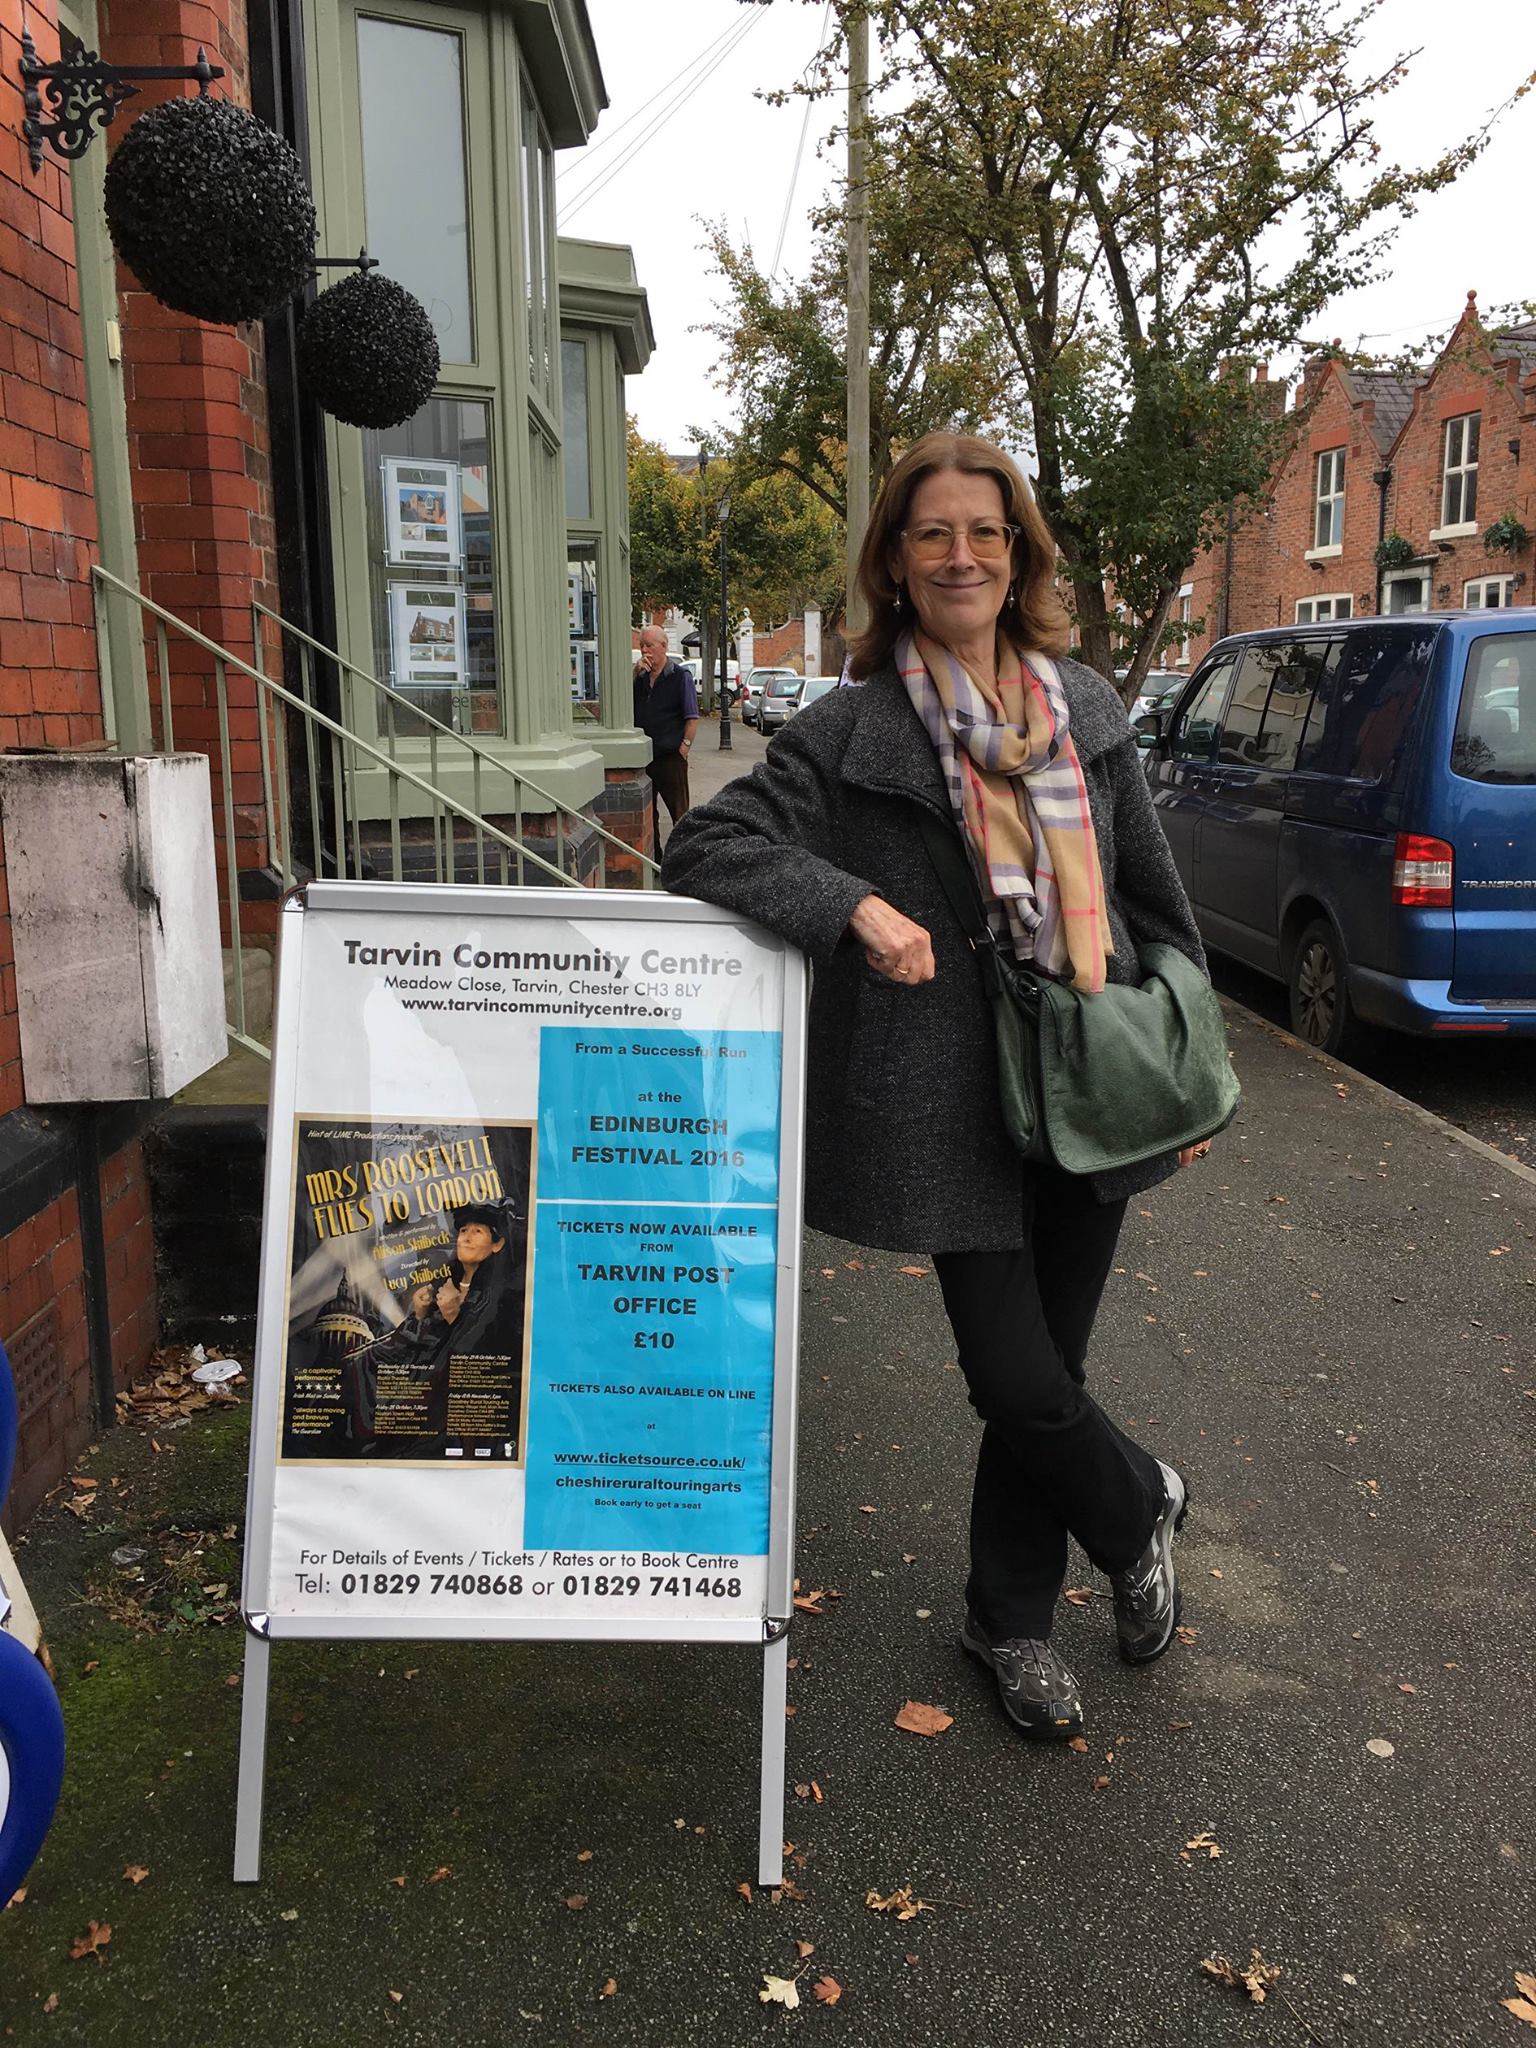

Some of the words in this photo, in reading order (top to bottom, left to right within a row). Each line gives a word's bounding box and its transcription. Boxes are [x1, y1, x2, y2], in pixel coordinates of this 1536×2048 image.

[344, 940, 441, 968] Tarvin
[453, 943, 630, 978] Community
[641, 949, 743, 977] Centre
[383, 974, 452, 991] Meadow
[458, 976, 506, 994] Close,
[512, 978, 563, 995] Tarvin,
[568, 980, 630, 996] Chester
[634, 982, 670, 997] CH3
[674, 983, 702, 998] 8LY
[401, 998, 683, 1020] www.tarvincommunitycentre.org
[575, 1043, 613, 1055] From
[618, 1046, 627, 1055] a
[632, 1044, 714, 1058] Successful
[719, 1047, 747, 1058] Run
[638, 1091, 654, 1103] at
[658, 1092, 682, 1103] the
[590, 1115, 728, 1136] EDINBURGH
[571, 1146, 683, 1166] FESTIVAL
[690, 1149, 746, 1167] 2016
[306, 1165, 358, 1205] MRS
[362, 1135, 494, 1193] ROOSEVELT
[313, 1196, 375, 1239] FLIES
[379, 1190, 409, 1224] TO
[415, 1169, 503, 1217] LONDON
[557, 1221, 624, 1234] TICKETS
[629, 1223, 666, 1235] NOW
[670, 1224, 758, 1237] AVAILABLE
[408, 1231, 451, 1251] Skilbeck
[640, 1243, 674, 1253] FROM
[384, 1277, 409, 1291] Lucy
[409, 1264, 452, 1285] Skilbeck
[577, 1264, 665, 1282] TARVIN
[674, 1266, 735, 1284] POST
[613, 1297, 697, 1315] OFFICE
[634, 1332, 675, 1349] £10
[549, 1383, 600, 1394] TICKETS
[604, 1384, 635, 1395] ALSO
[638, 1386, 704, 1397] AVAILABLE
[647, 1422, 656, 1430] at
[554, 1452, 746, 1470] www.ticketsource.co.uk/
[555, 1476, 742, 1494] cheshireruraltouringarts
[594, 1498, 617, 1507] Book
[620, 1499, 642, 1509] early
[644, 1500, 653, 1508] to
[656, 1501, 671, 1510] get
[682, 1502, 702, 1510] seat
[300, 1550, 329, 1565] For
[332, 1550, 387, 1566] Details
[392, 1550, 409, 1566] of
[414, 1551, 464, 1567] Events
[469, 1551, 478, 1568] /
[482, 1551, 535, 1567] Tickets
[539, 1552, 548, 1568] /
[553, 1552, 594, 1568] Rates
[600, 1556, 617, 1568] or
[620, 1554, 636, 1568] to
[641, 1552, 682, 1569] Book
[686, 1552, 739, 1569] Centre
[295, 1573, 331, 1593] Tel:
[341, 1573, 420, 1595] 01829
[430, 1574, 523, 1596] 740868
[532, 1580, 555, 1596] or
[563, 1575, 640, 1597] 01829
[649, 1576, 742, 1598] 741468
